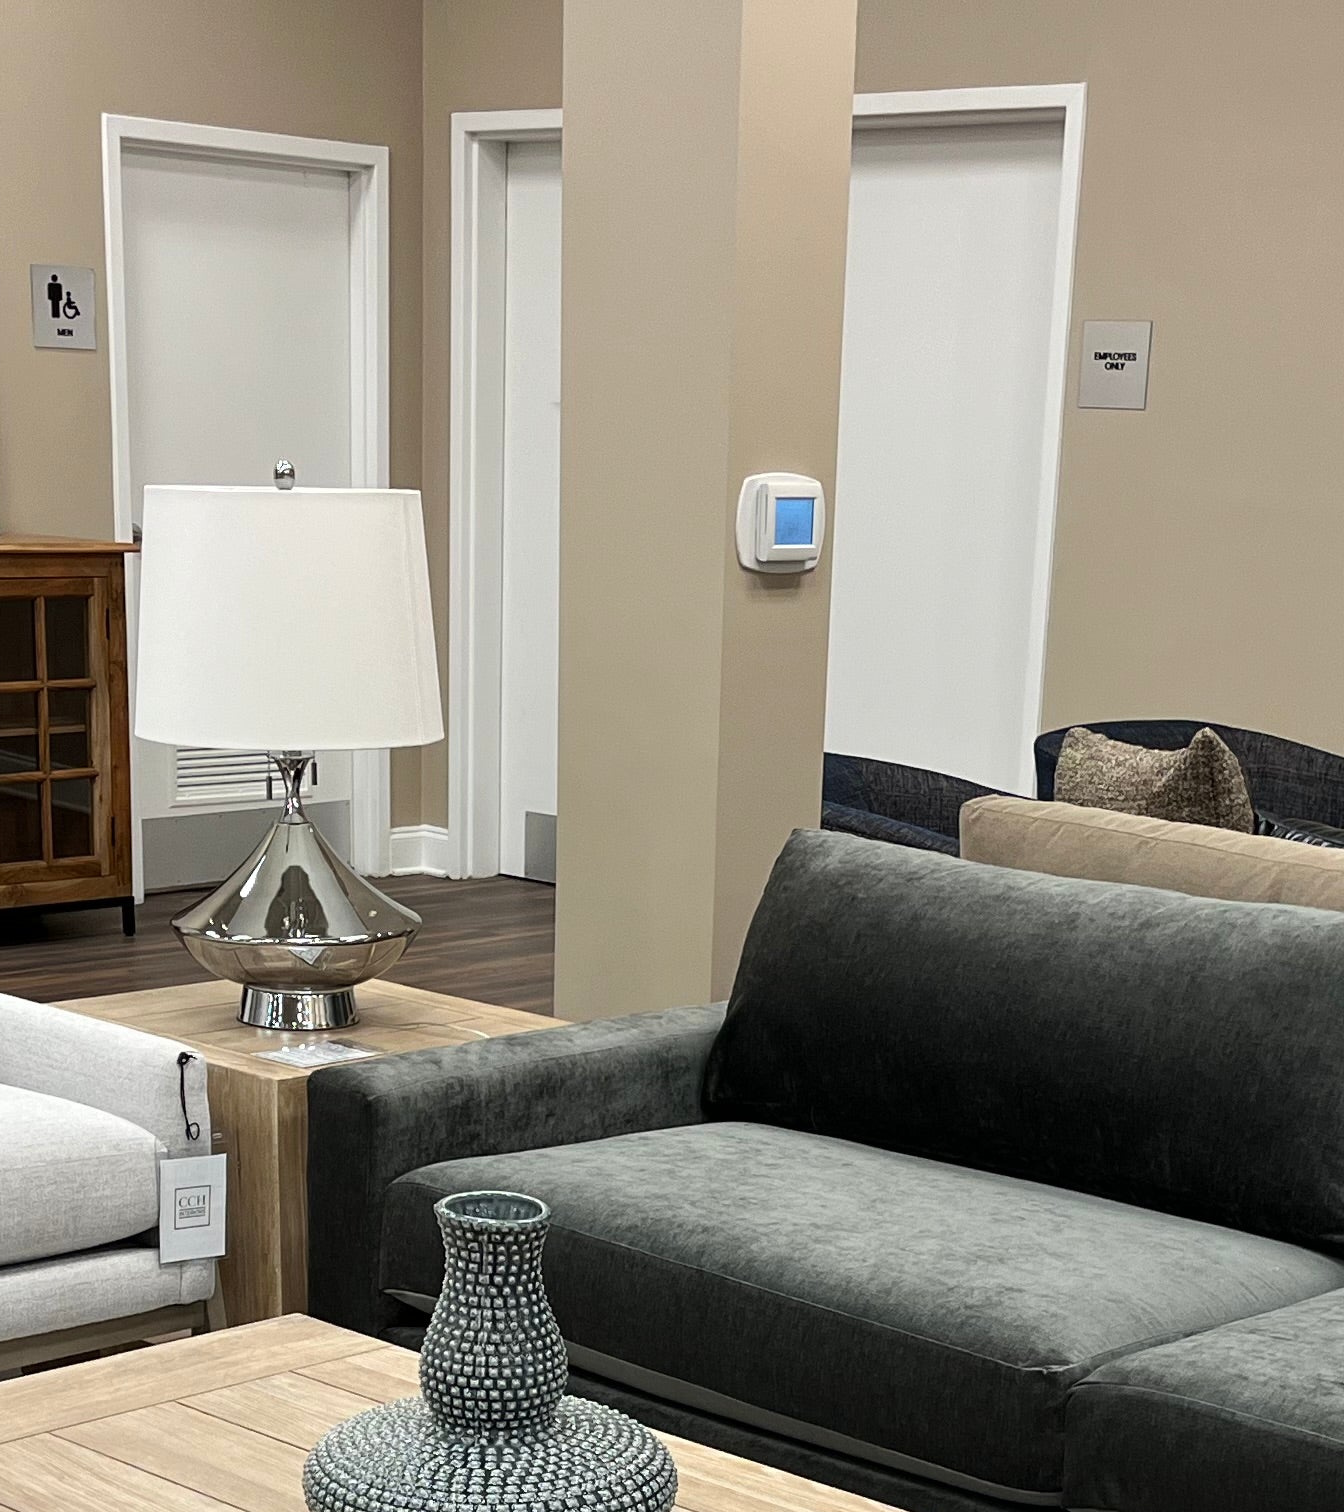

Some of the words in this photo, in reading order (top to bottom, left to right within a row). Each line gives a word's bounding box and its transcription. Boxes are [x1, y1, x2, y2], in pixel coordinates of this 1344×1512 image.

[57, 328, 73, 337] MEN
[1094, 352, 1137, 361] EMPLOYEES
[1104, 362, 1125, 370] ONLY
[178, 1194, 206, 1208] CCH
